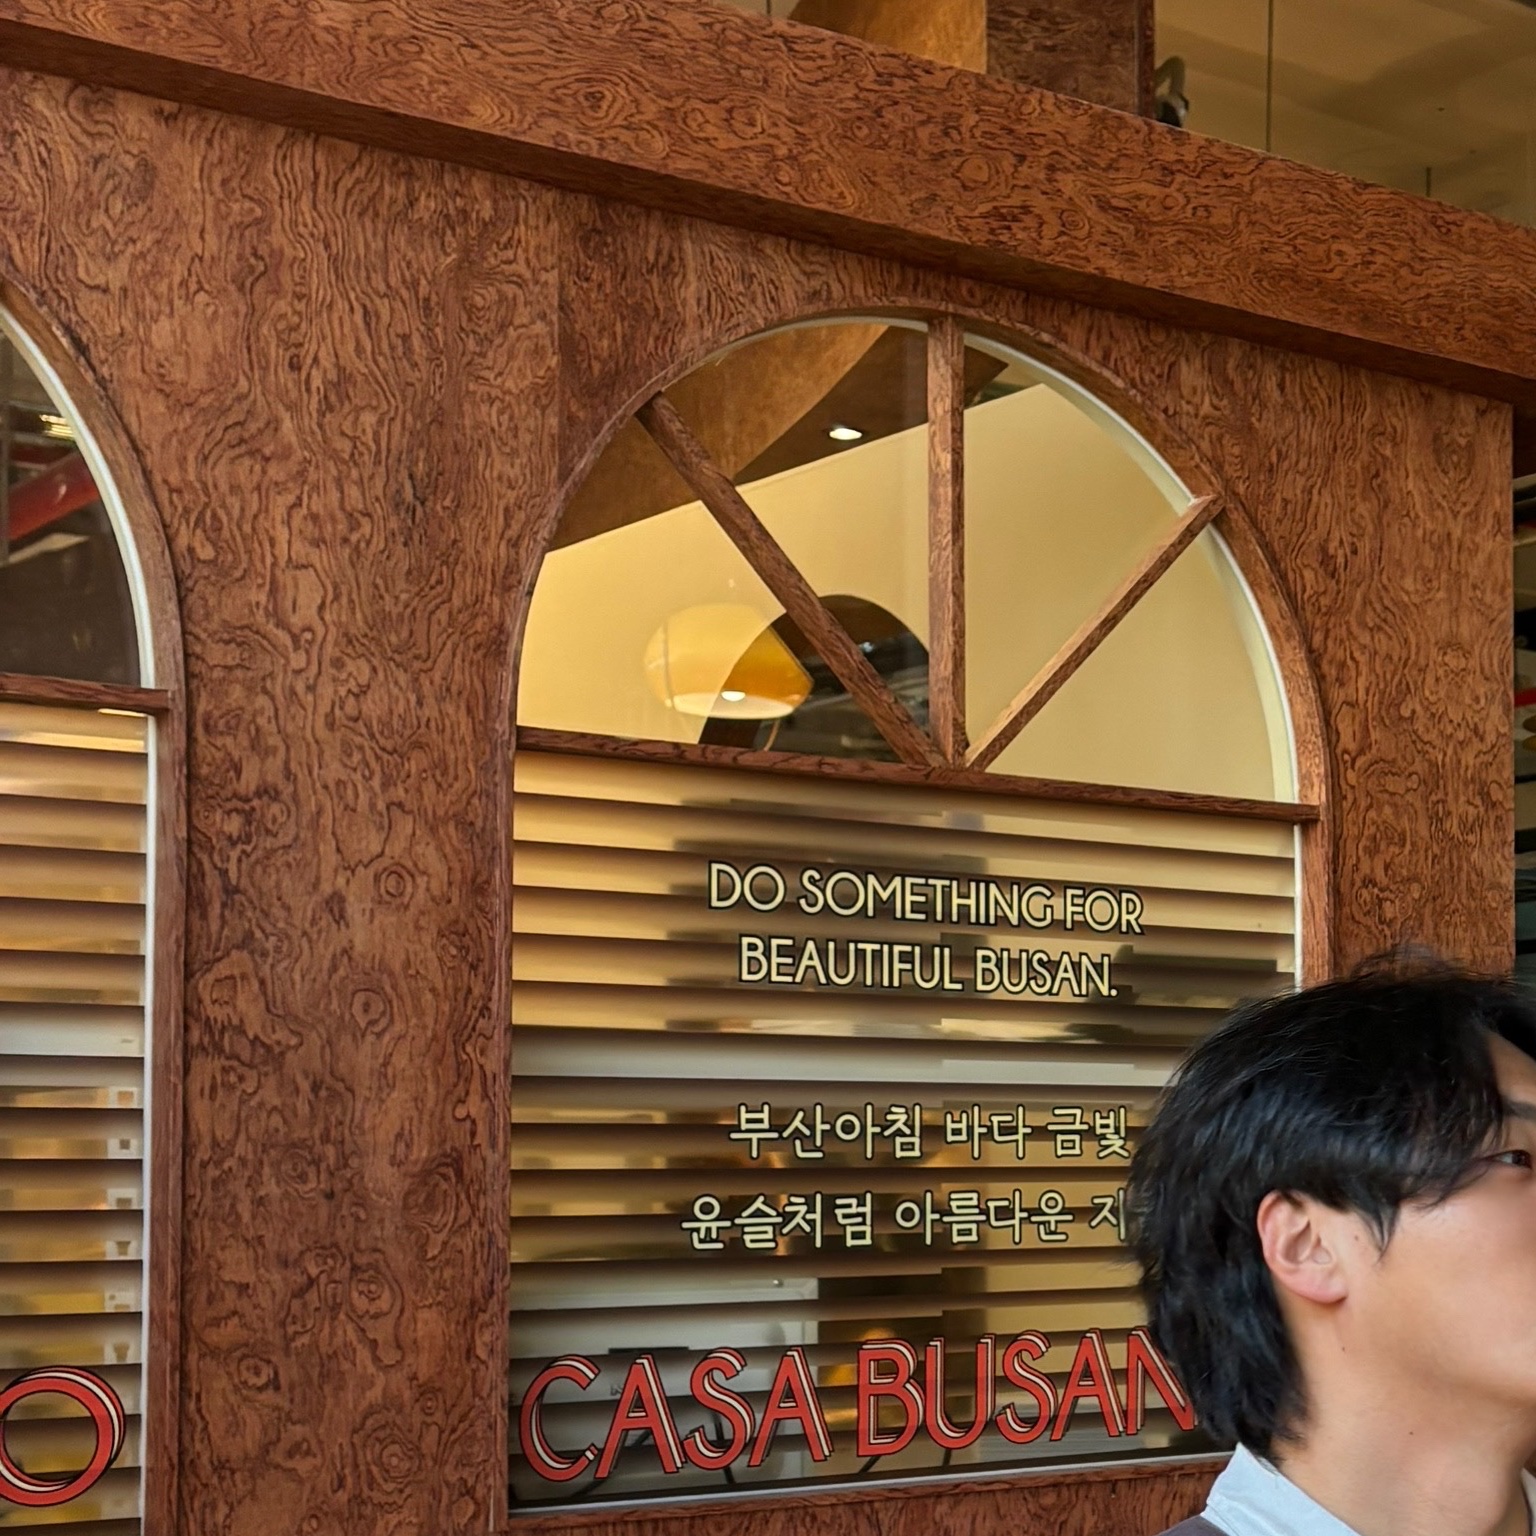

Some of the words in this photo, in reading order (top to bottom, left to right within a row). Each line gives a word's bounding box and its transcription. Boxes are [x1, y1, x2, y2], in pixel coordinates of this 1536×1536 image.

[708, 861, 787, 911] DO
[798, 867, 1055, 928] SOMETHING
[1064, 886, 1145, 935] FOR
[739, 934, 964, 991] BEAUTIFUL
[975, 946, 1119, 997] BUSAN.
[729, 1102, 923, 1160] 부산아침
[945, 1103, 1033, 1160] 바다
[1046, 1105, 1131, 1160] 금빛
[680, 1191, 873, 1251] 윤슬처럼
[894, 1189, 1075, 1246] 아름다운
[1088, 1188, 1127, 1242] 지
[519, 1346, 834, 1482] CASA
[857, 1325, 1199, 1458] BUSAN
